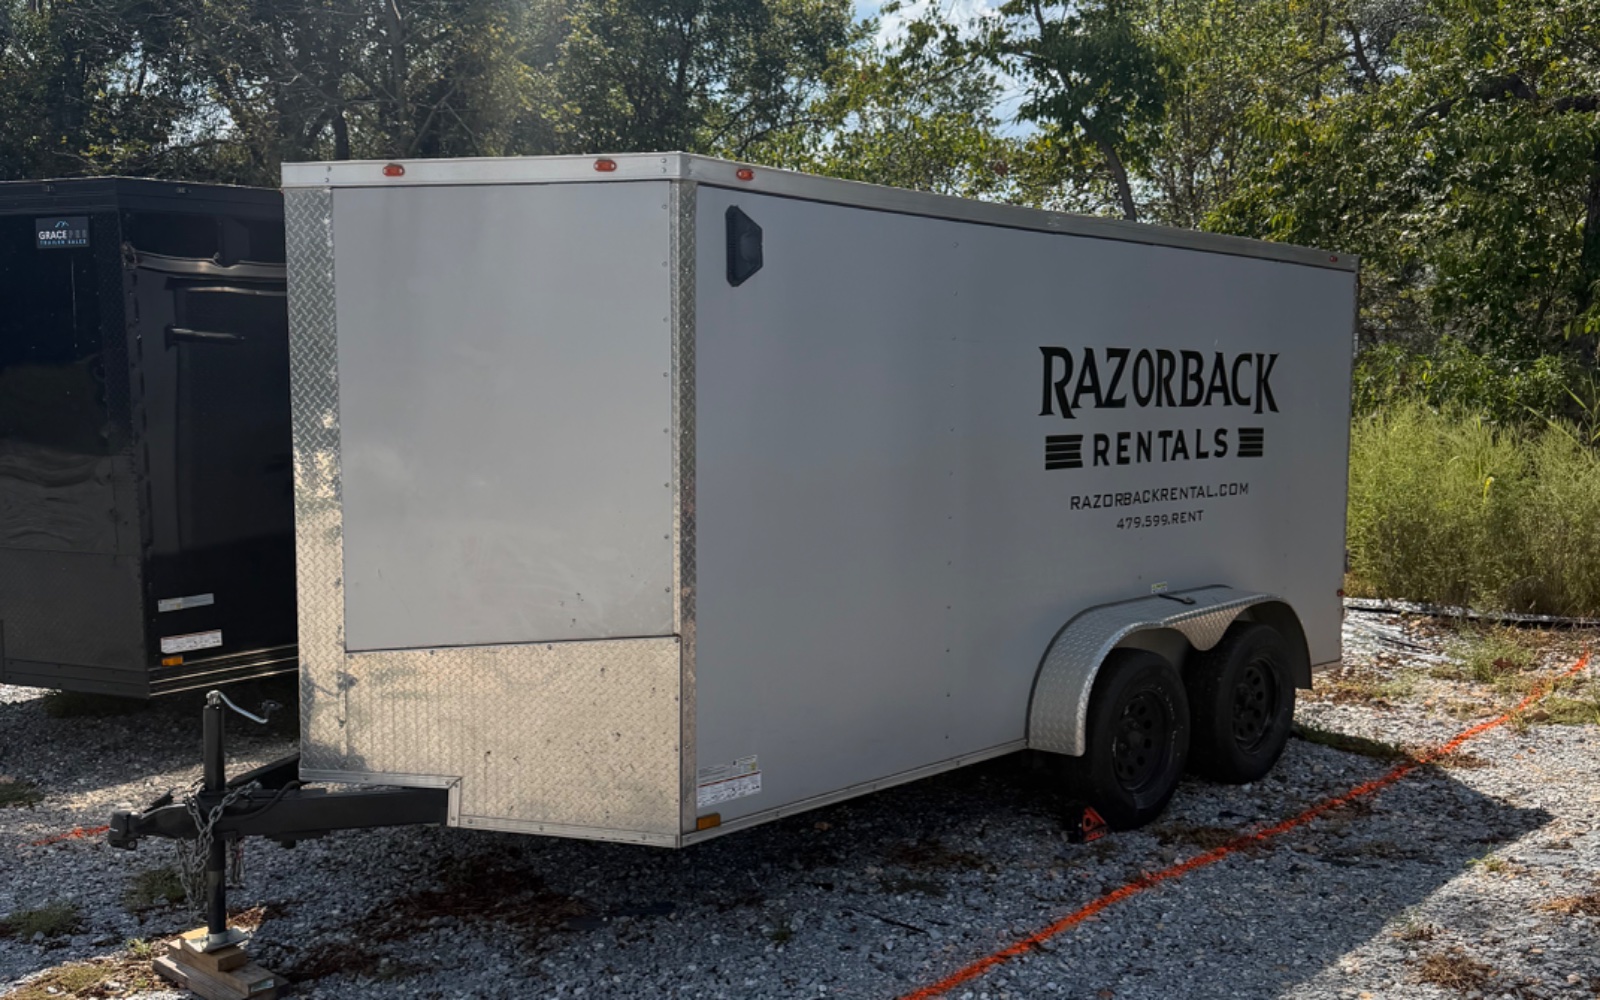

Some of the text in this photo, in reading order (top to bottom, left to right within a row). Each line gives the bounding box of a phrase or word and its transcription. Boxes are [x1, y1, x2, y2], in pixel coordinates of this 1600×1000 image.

[1038, 346, 1280, 419] RAZORBACK
[1093, 428, 1228, 467] RENTALS
[1070, 482, 1249, 510] RAZORBACKRENTAL.COM
[1116, 509, 1204, 530] 479.599.RENT
